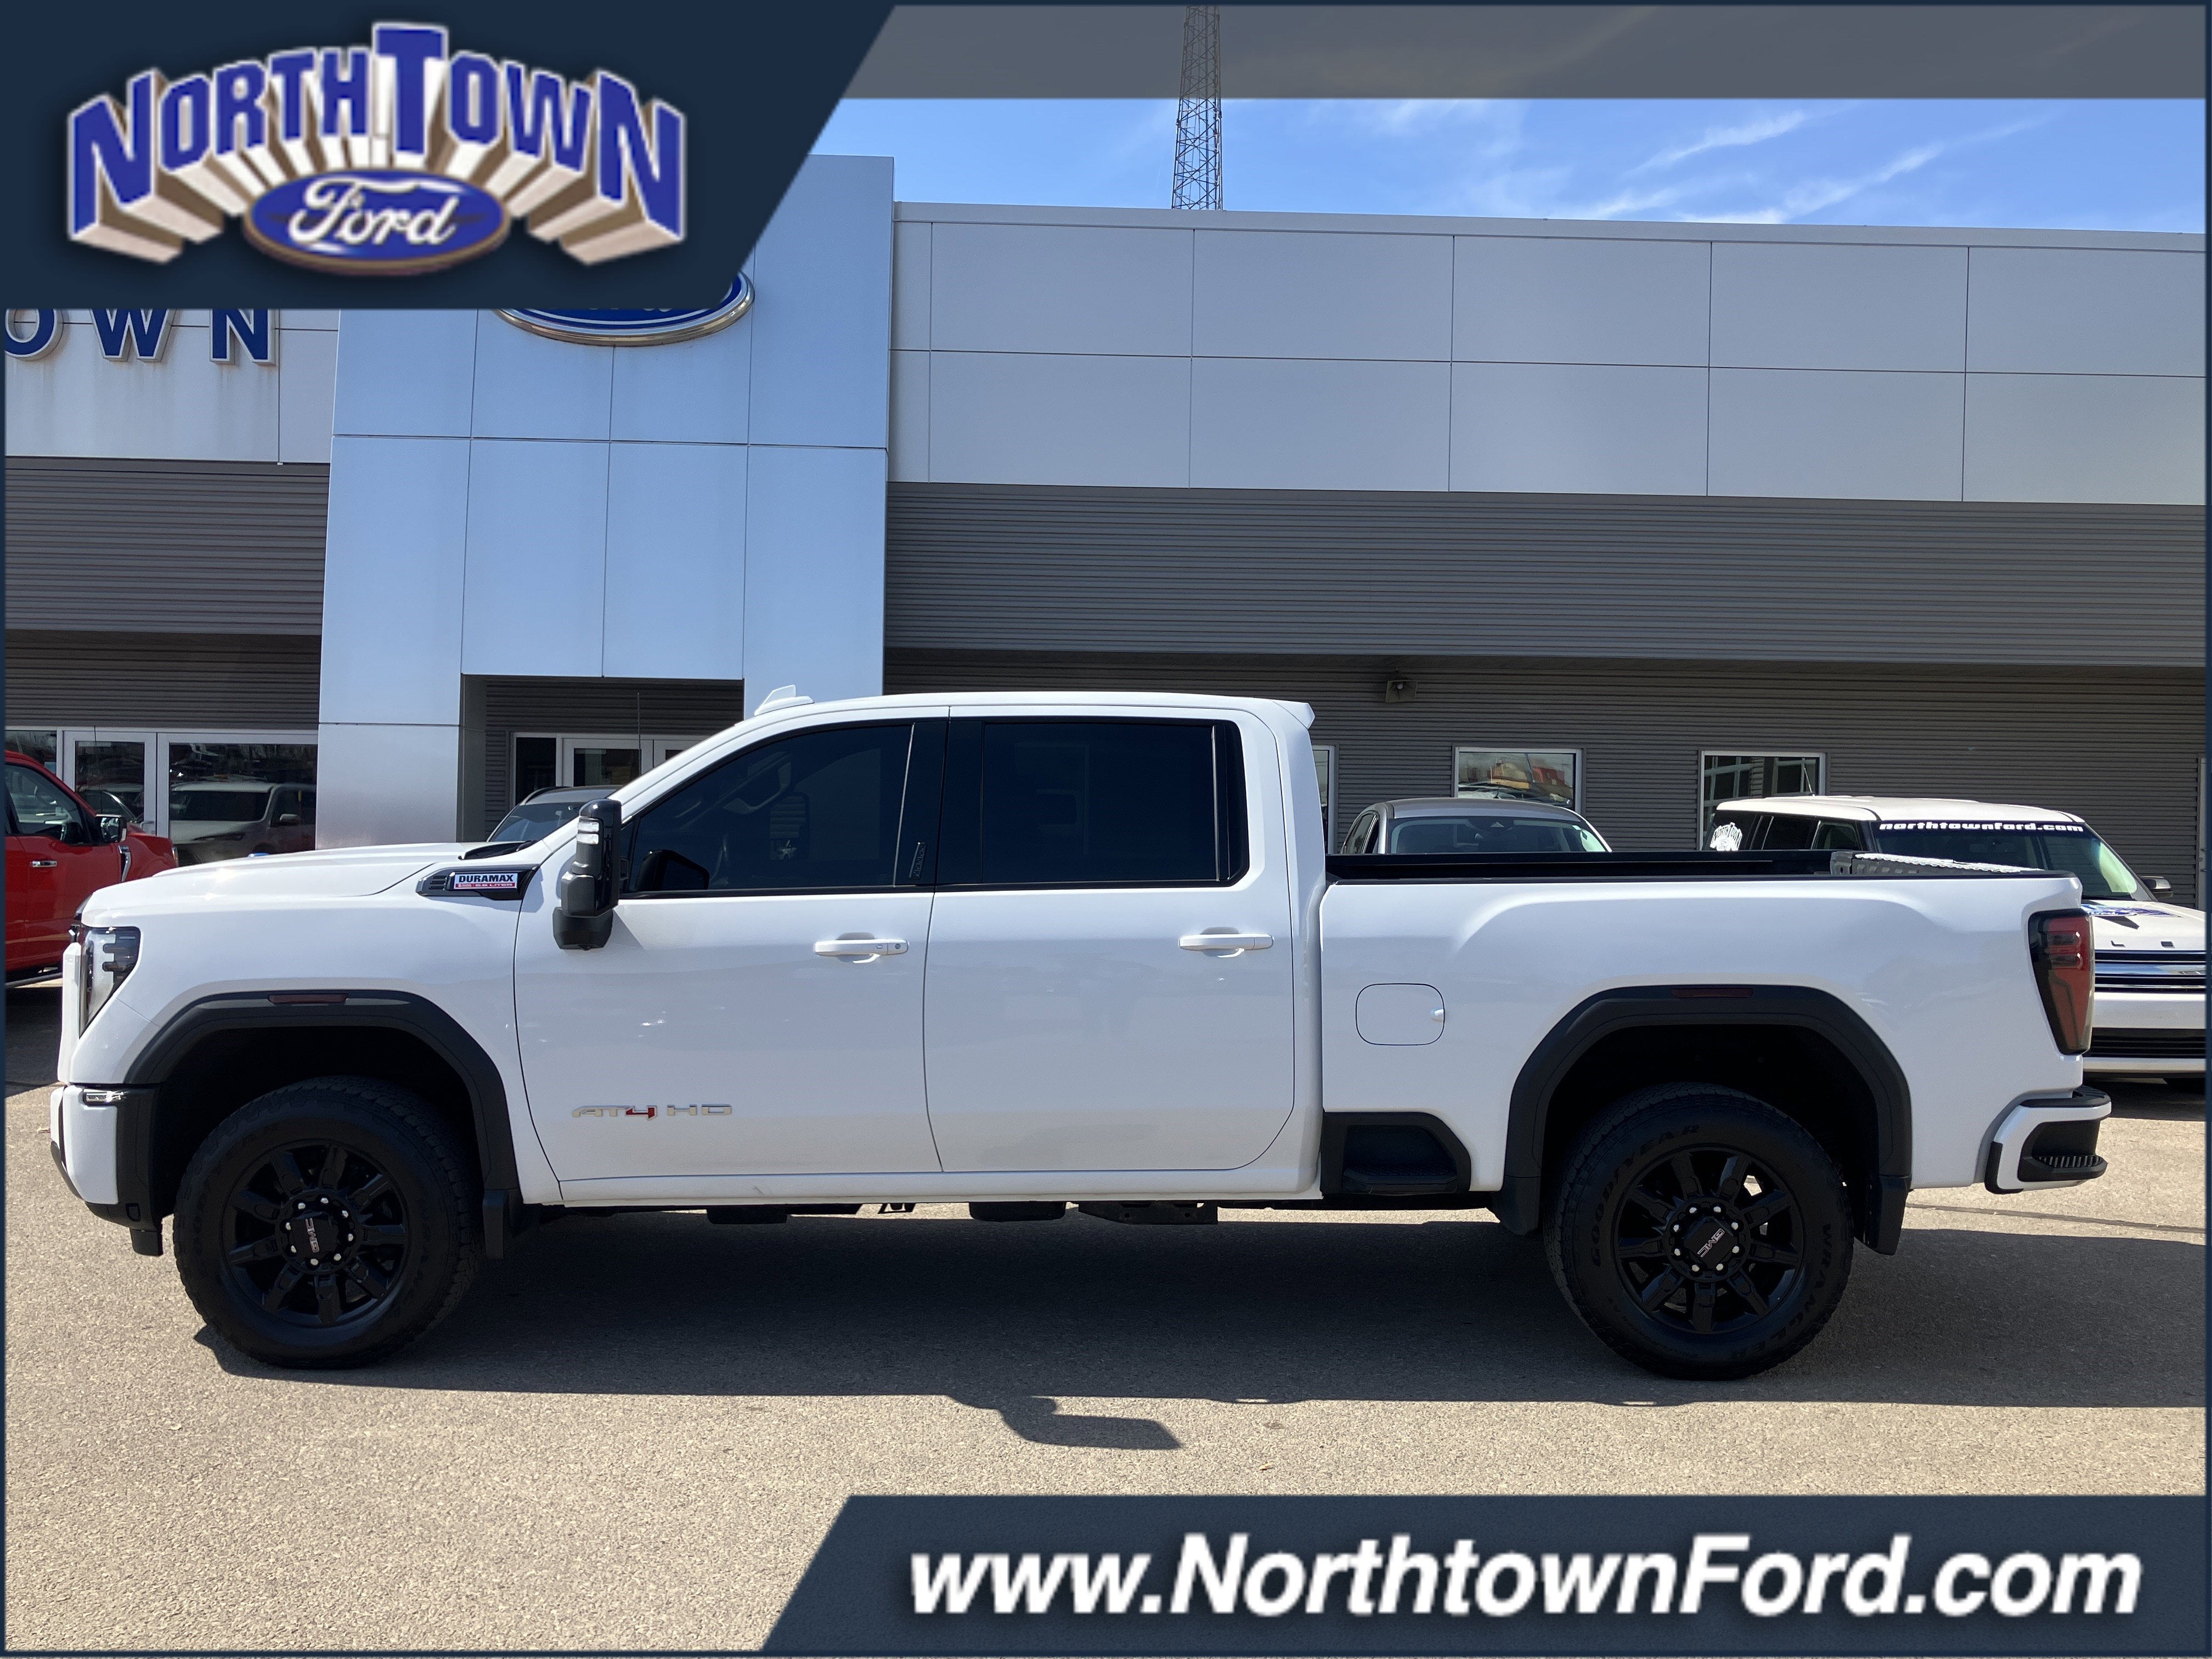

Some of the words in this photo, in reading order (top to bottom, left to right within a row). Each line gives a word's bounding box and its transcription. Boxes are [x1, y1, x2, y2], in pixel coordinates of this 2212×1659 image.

[1879, 822, 2084, 832] northtownford.com
[459, 874, 514, 883] DURAMAX
[572, 1105, 657, 1120] AT4
[667, 1104, 732, 1116] HD
[304, 1217, 320, 1253] GMC
[1697, 1228, 1725, 1258] GMC
